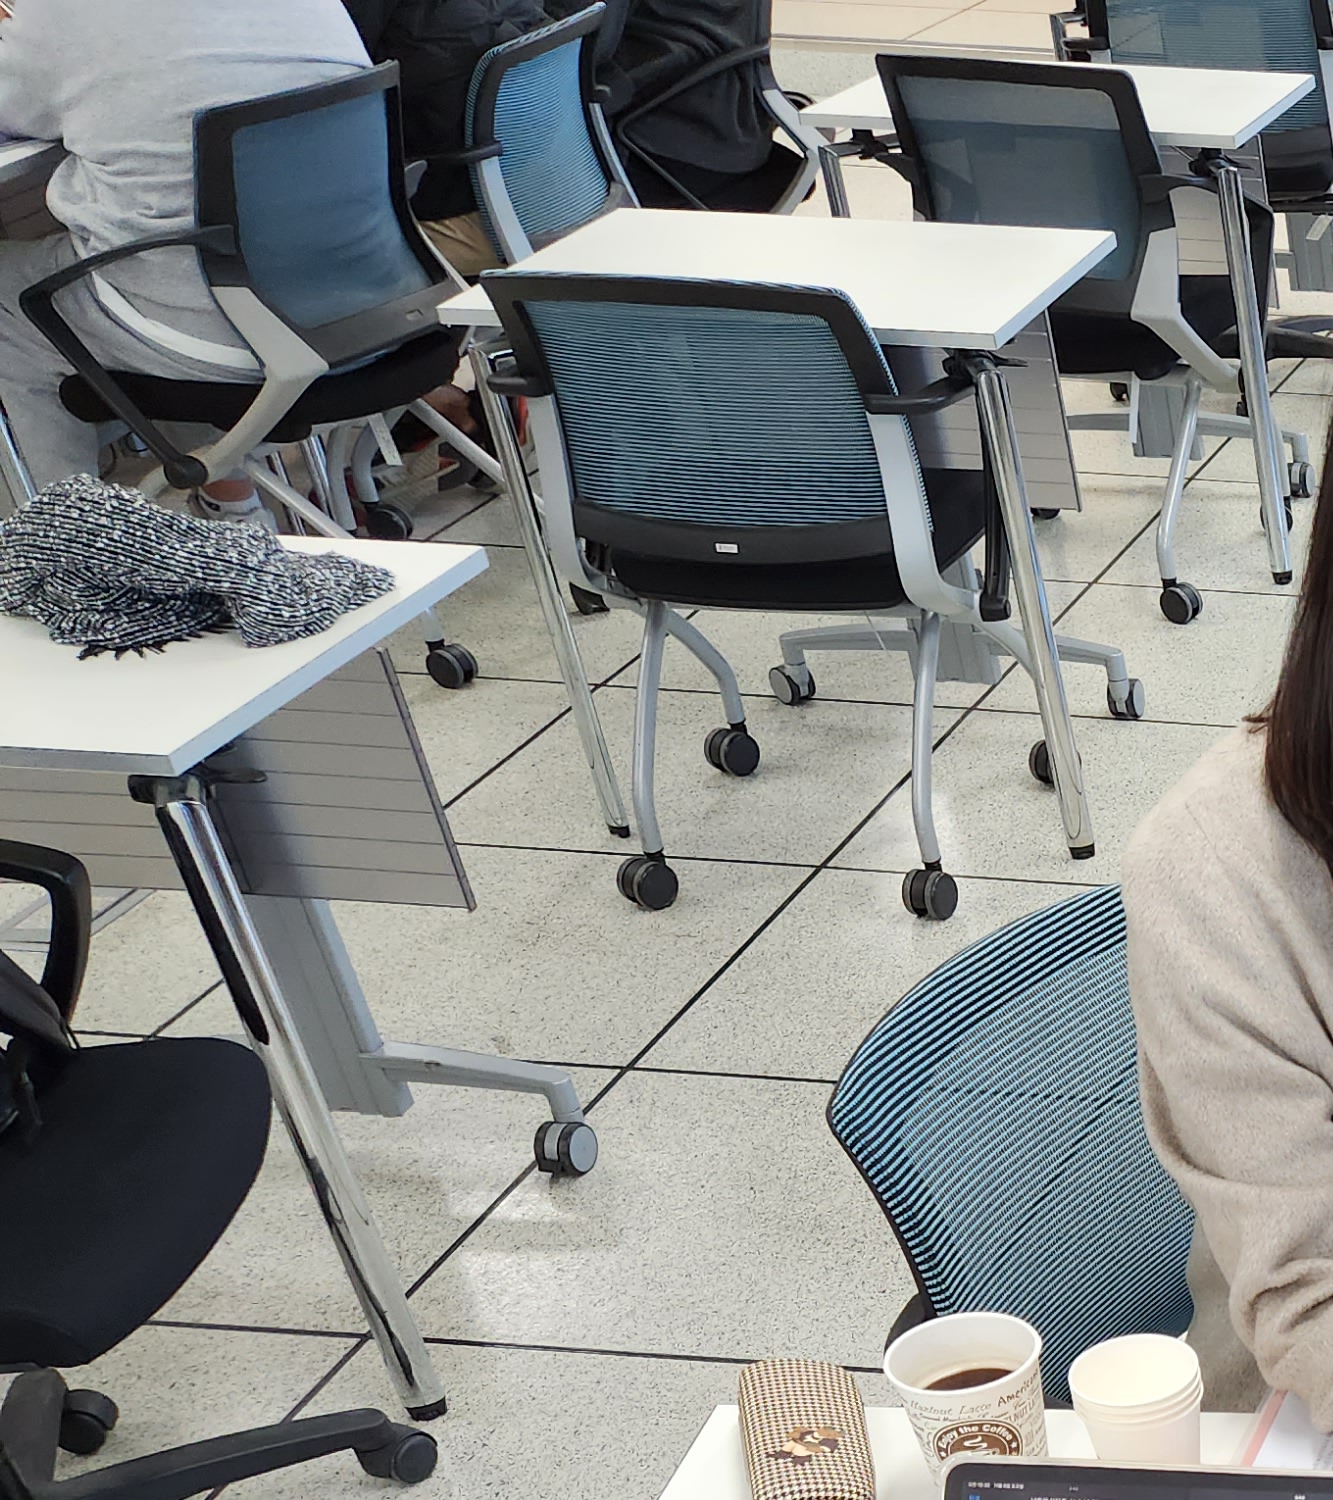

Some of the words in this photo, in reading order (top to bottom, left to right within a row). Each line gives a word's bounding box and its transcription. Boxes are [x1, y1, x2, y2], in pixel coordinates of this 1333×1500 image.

[938, 1431, 960, 1449] Enjoy
[959, 1423, 979, 1435] the
[982, 1424, 1013, 1441] Coffee
